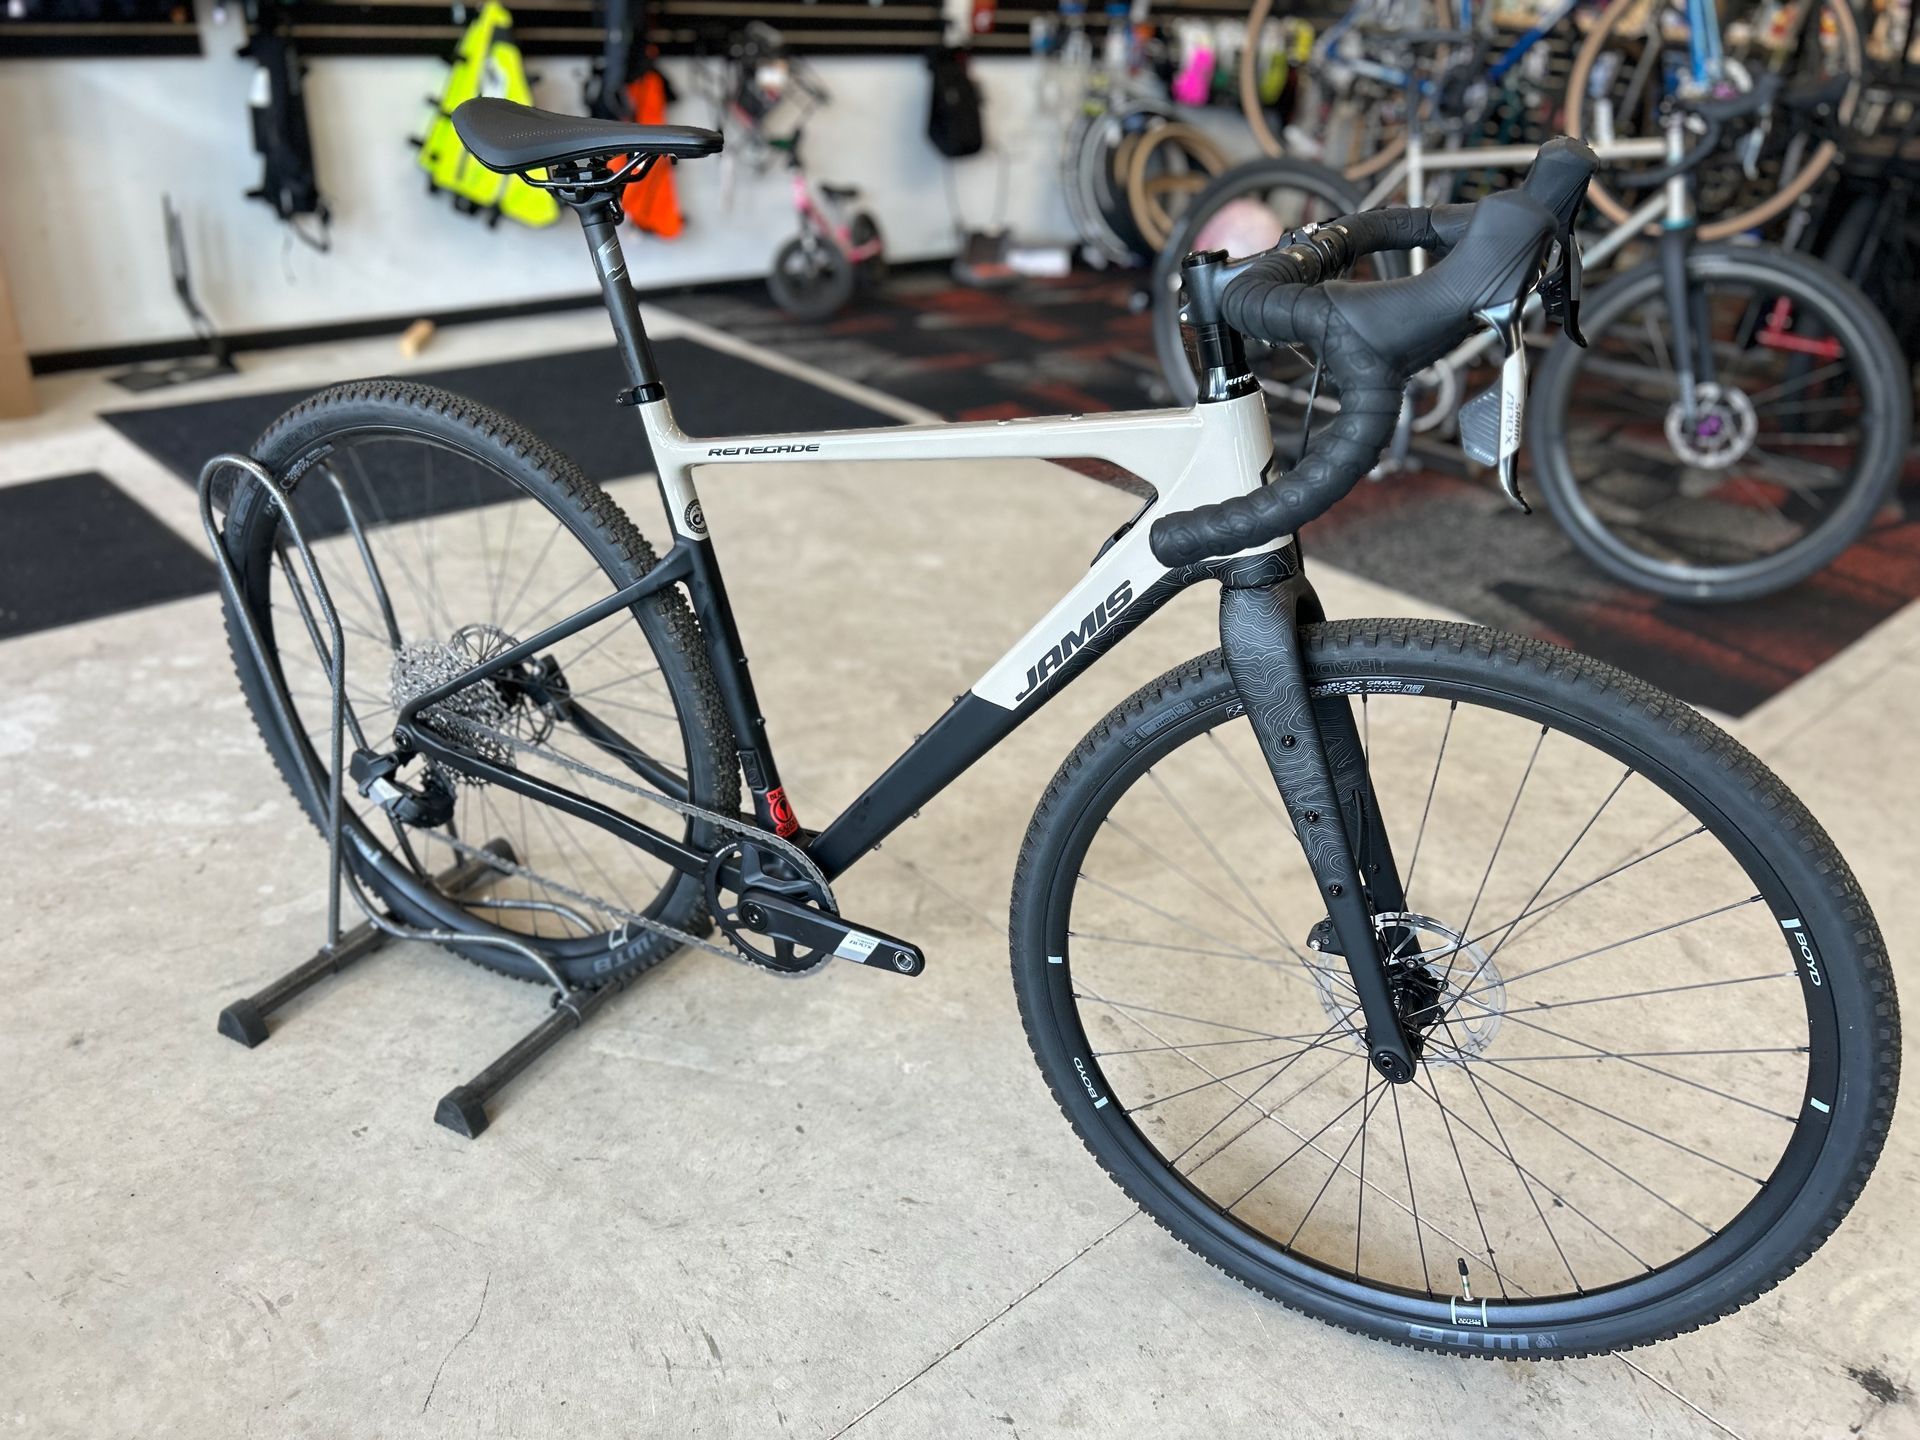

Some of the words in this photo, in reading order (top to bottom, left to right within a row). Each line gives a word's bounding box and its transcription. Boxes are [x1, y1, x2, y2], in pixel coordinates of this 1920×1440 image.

[708, 444, 820, 457] RENEGADE
[1015, 579, 1133, 702] JAMIS
[1198, 695, 1219, 708] 700
[1155, 713, 1177, 728] LIGHT
[1793, 931, 1821, 986] BOYD
[1073, 1056, 1098, 1098] BOYD
[1408, 1322, 1530, 1350] WTB
